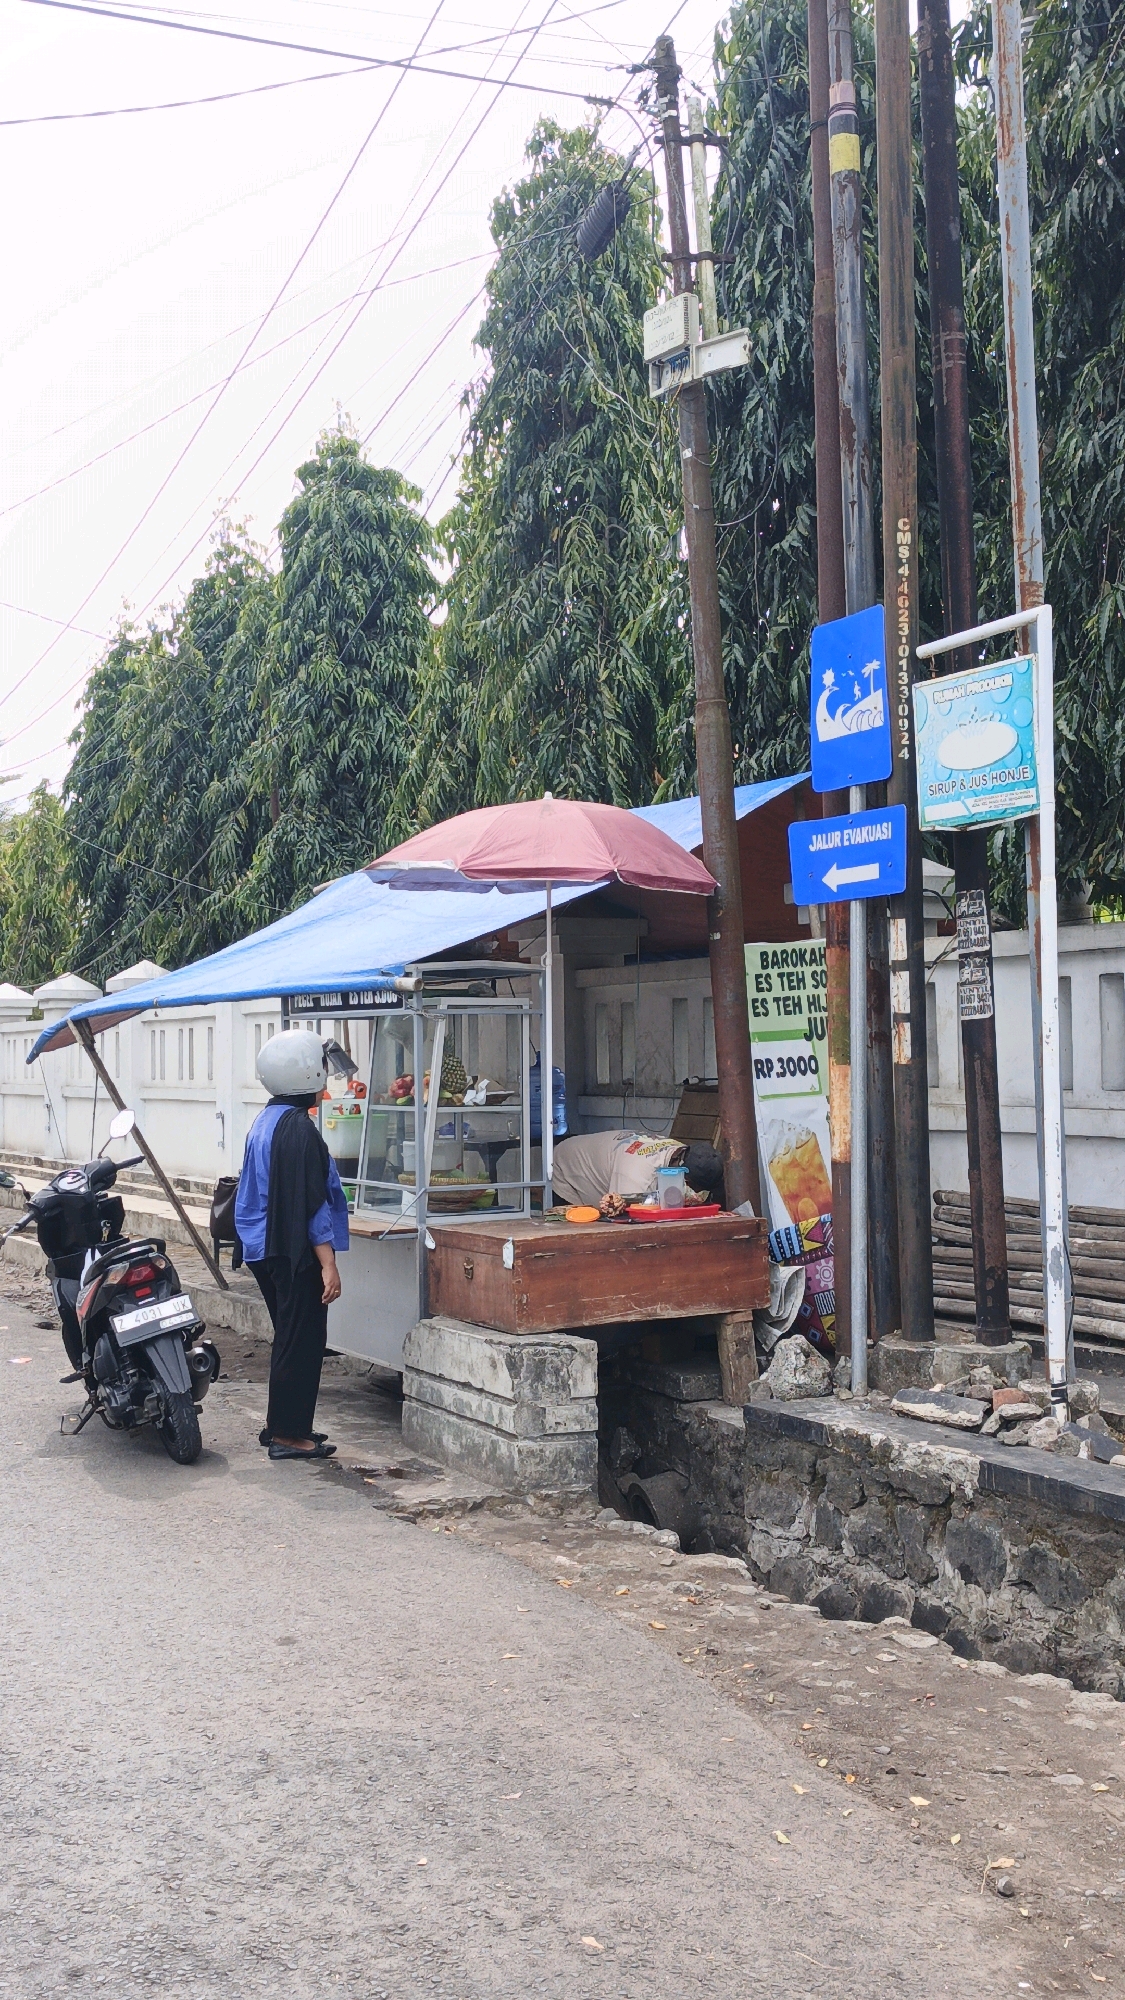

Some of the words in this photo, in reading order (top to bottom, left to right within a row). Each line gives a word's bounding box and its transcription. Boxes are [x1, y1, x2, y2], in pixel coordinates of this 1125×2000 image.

[929, 780, 957, 796] SIRUP
[959, 779, 966, 790] &
[969, 774, 988, 788] JUS
[991, 766, 1029, 786] HONJE
[809, 831, 841, 852] JALUR
[843, 821, 892, 846] EVAKUASI
[760, 947, 826, 971] BAROKAH
[755, 973, 773, 993] ES
[777, 970, 806, 992] TEH
[751, 997, 770, 1017] ES
[773, 994, 803, 1017] TEH
[754, 1055, 819, 1080] RP.3000
[118, 1318, 126, 1330] Z
[134, 1306, 163, 1324] 4031
[172, 1298, 189, 1312] UK
